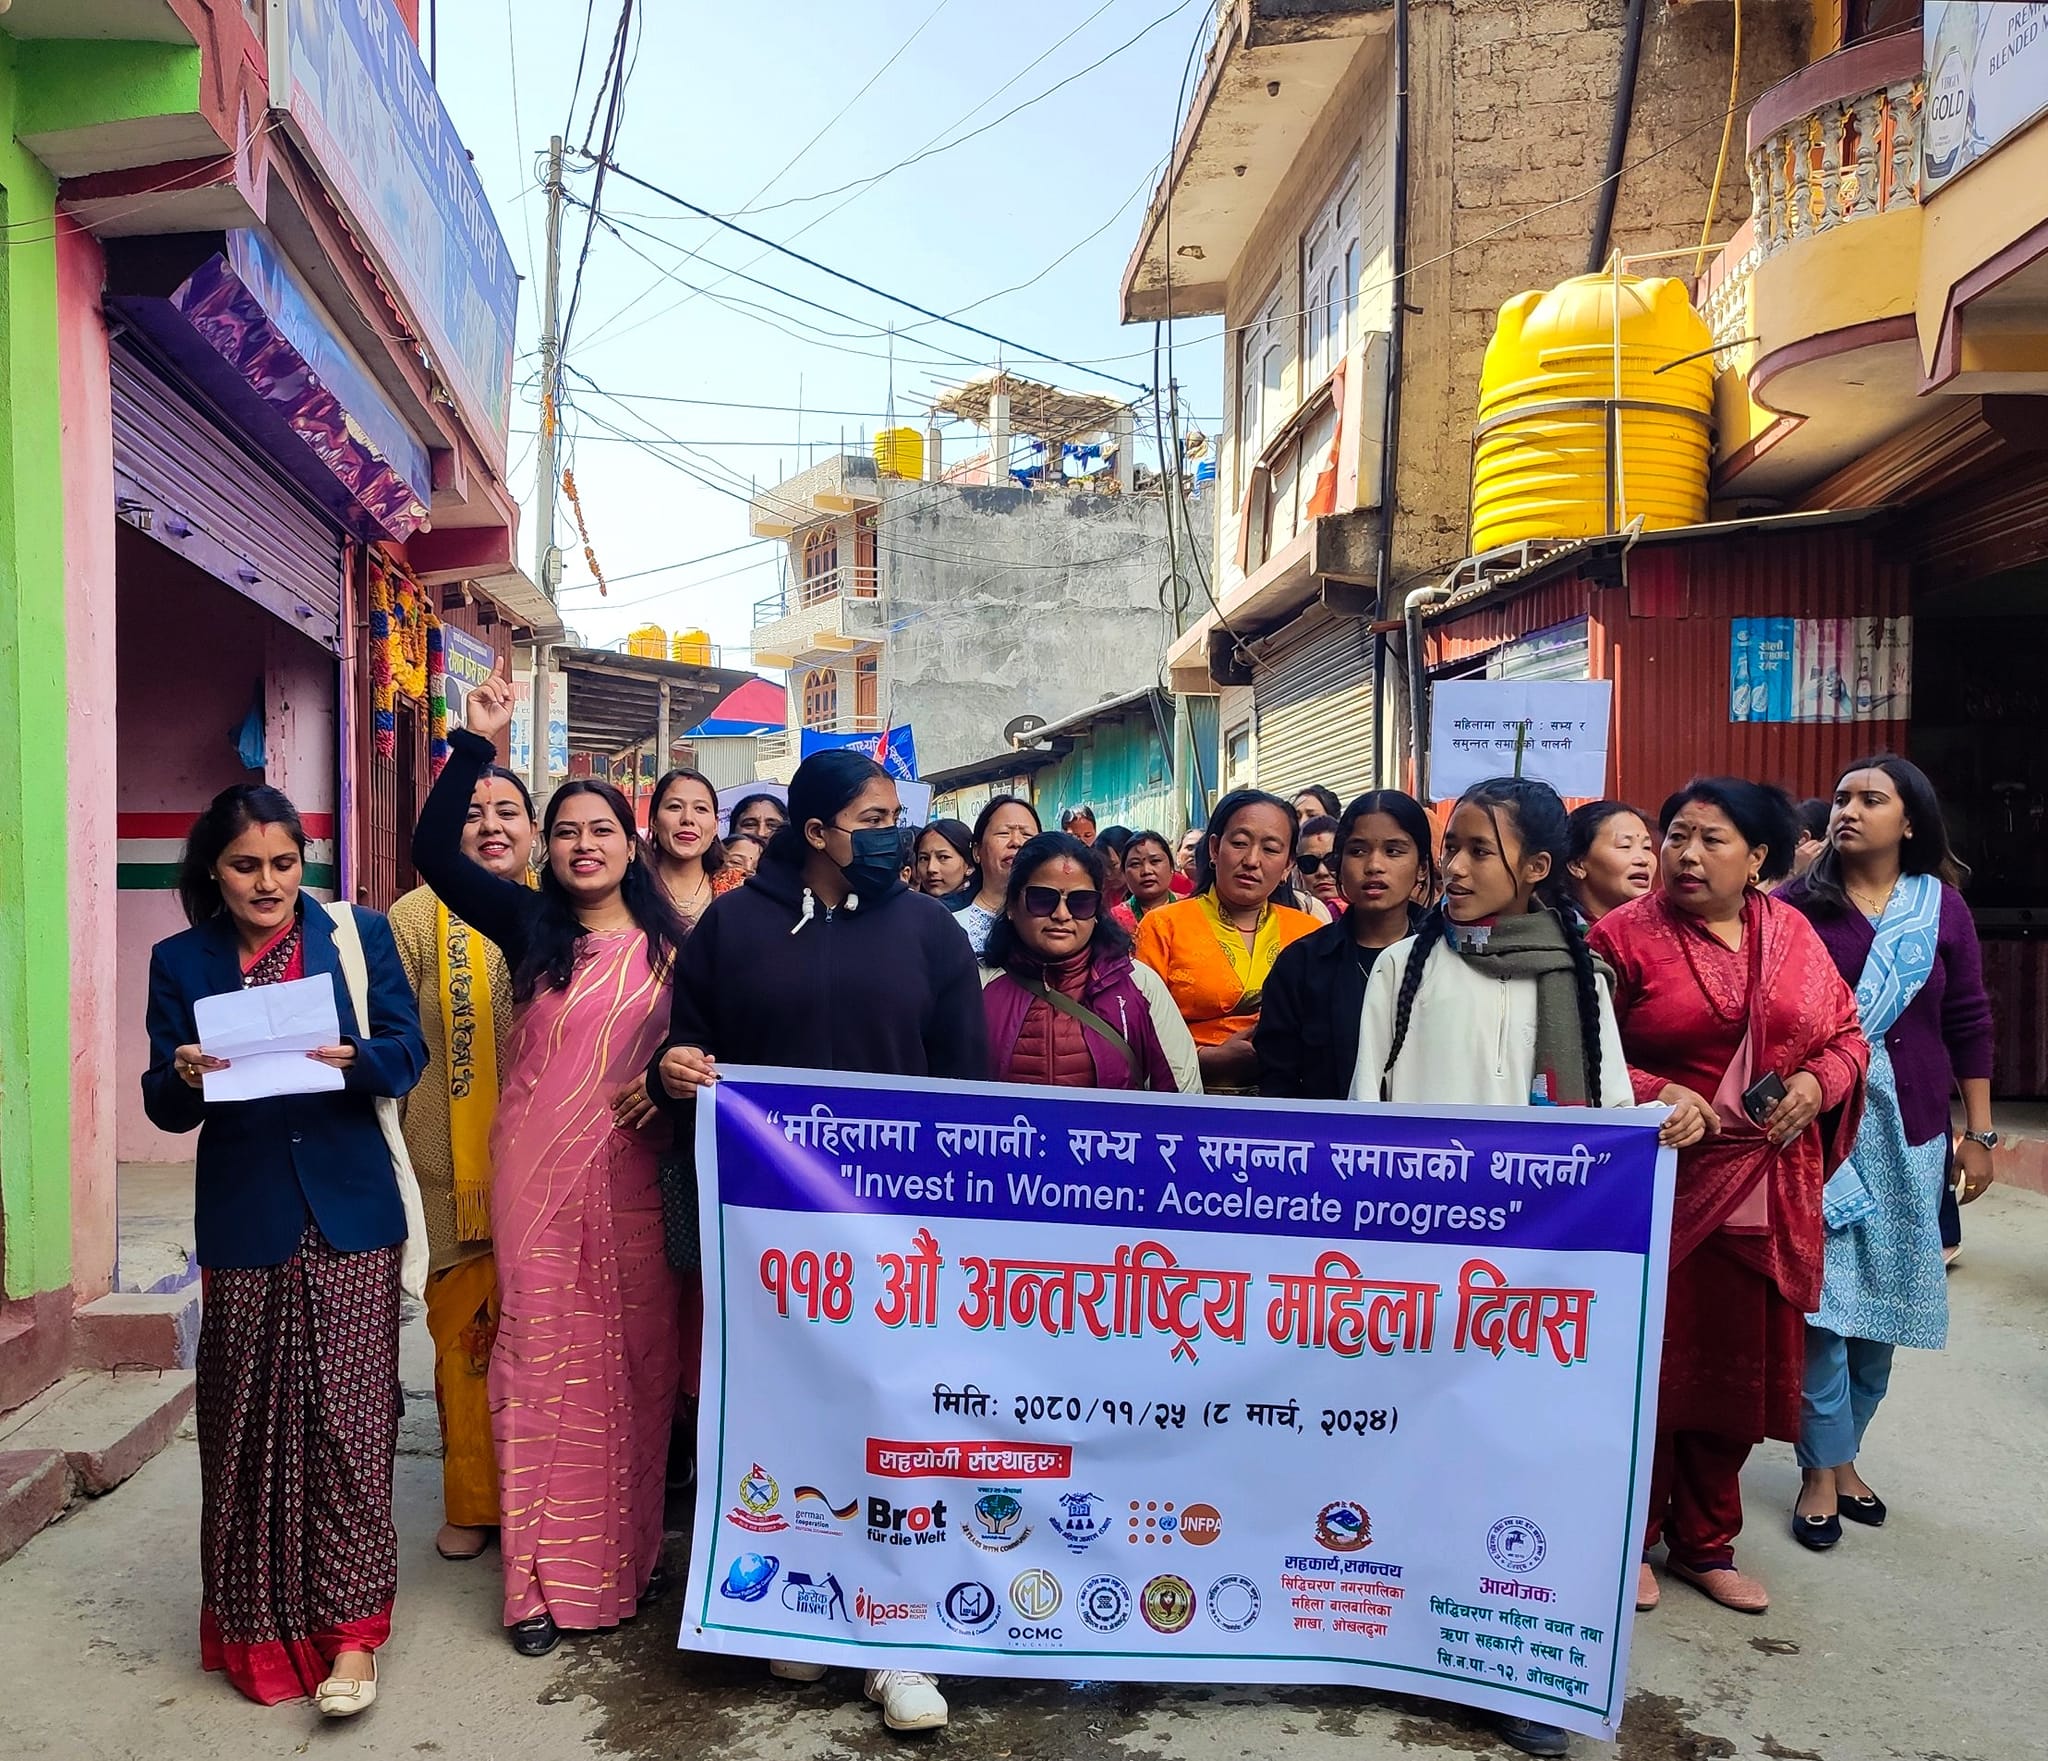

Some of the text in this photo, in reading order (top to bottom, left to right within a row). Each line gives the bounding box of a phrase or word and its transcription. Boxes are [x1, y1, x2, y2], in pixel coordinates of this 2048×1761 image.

[1989, 21, 2038, 76] BLENDED
[1931, 89, 1964, 121] GOLD
[1453, 717, 1496, 731] महिलामा
[1550, 720, 1573, 732] सभ्य
[1579, 721, 1586, 732] र
[1452, 738, 1490, 751] समुन्नत
[766, 1103, 1612, 1190] “महिलामा लगानी: सभ्य र समुन्नत समाजको थालनी”
[841, 1164, 1522, 1236] "Invest in Women: Accelerate progress"
[759, 1247, 855, 1326] ११४
[1266, 1250, 1443, 1358] महिला
[1452, 1257, 1597, 1370] दिवस
[932, 1383, 1399, 1437] मिति: २०८०/११/२५ (८ मार्च, २०२४)
[878, 1446, 962, 1474] सहयोगी
[795, 1510, 825, 1521] german
[867, 1496, 947, 1531] Brot
[1180, 1516, 1222, 1533] UNFPA
[867, 1528, 947, 1546] für die Welt
[1280, 1574, 1405, 1599] सिद्धिचरण नगरपालिका
[1479, 1576, 1557, 1604] आयोजक:
[1291, 1594, 1392, 1617] महिला बालबालिका
[1430, 1595, 1493, 1623] सिद्धिचरण
[1498, 1608, 1539, 1630] महिला
[1580, 1625, 1604, 1643] तथा
[1008, 1627, 1063, 1640] OCMC
[1293, 1617, 1326, 1632] शाखा,
[1440, 1626, 1588, 1669] ऋण सहकारी संस्था लि.
